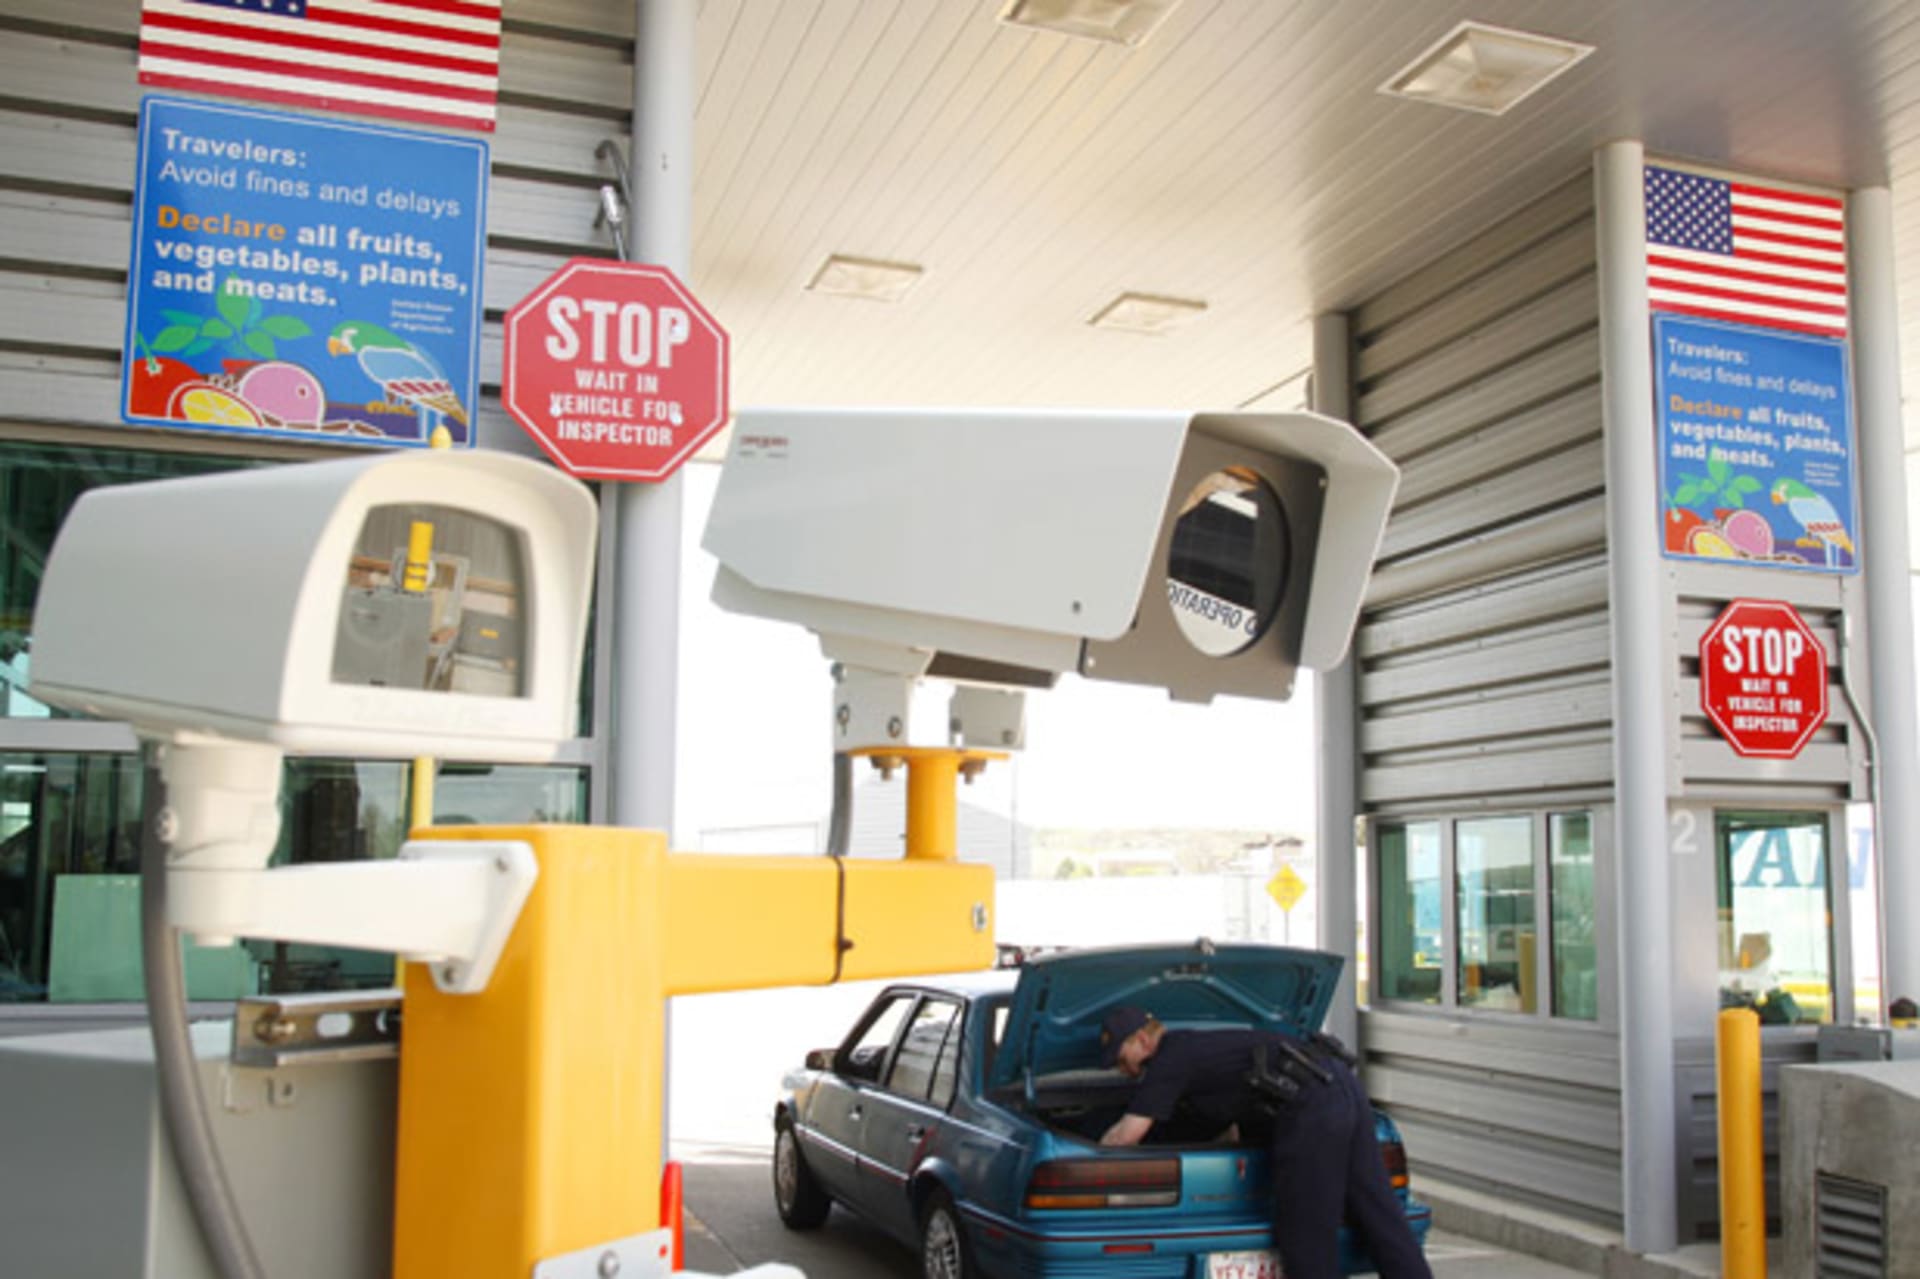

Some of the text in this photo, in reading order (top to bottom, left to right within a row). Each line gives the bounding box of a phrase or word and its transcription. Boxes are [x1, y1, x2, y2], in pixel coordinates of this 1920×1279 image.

[161, 128, 306, 167] Travelers:
[159, 160, 461, 219] Avoid fines and delays
[157, 204, 442, 263] Declare all fruits,
[152, 268, 336, 306] and meats.
[154, 240, 467, 295] vegetables, plants,
[545, 295, 690, 369] STOP
[575, 369, 659, 394] WAIT IN
[1667, 360, 1837, 401] Avoid fines and delays
[550, 393, 683, 425] VEHICLE FOR
[1670, 394, 1830, 433] Declare all fruits,
[557, 419, 673, 446] INSPECTOR
[1670, 420, 1780, 449] vegetables,
[1671, 441, 1775, 468] and meats.
[1722, 625, 1803, 676] STOP
[1733, 715, 1799, 733] INSPECTOR
[1669, 809, 1698, 853] 2
